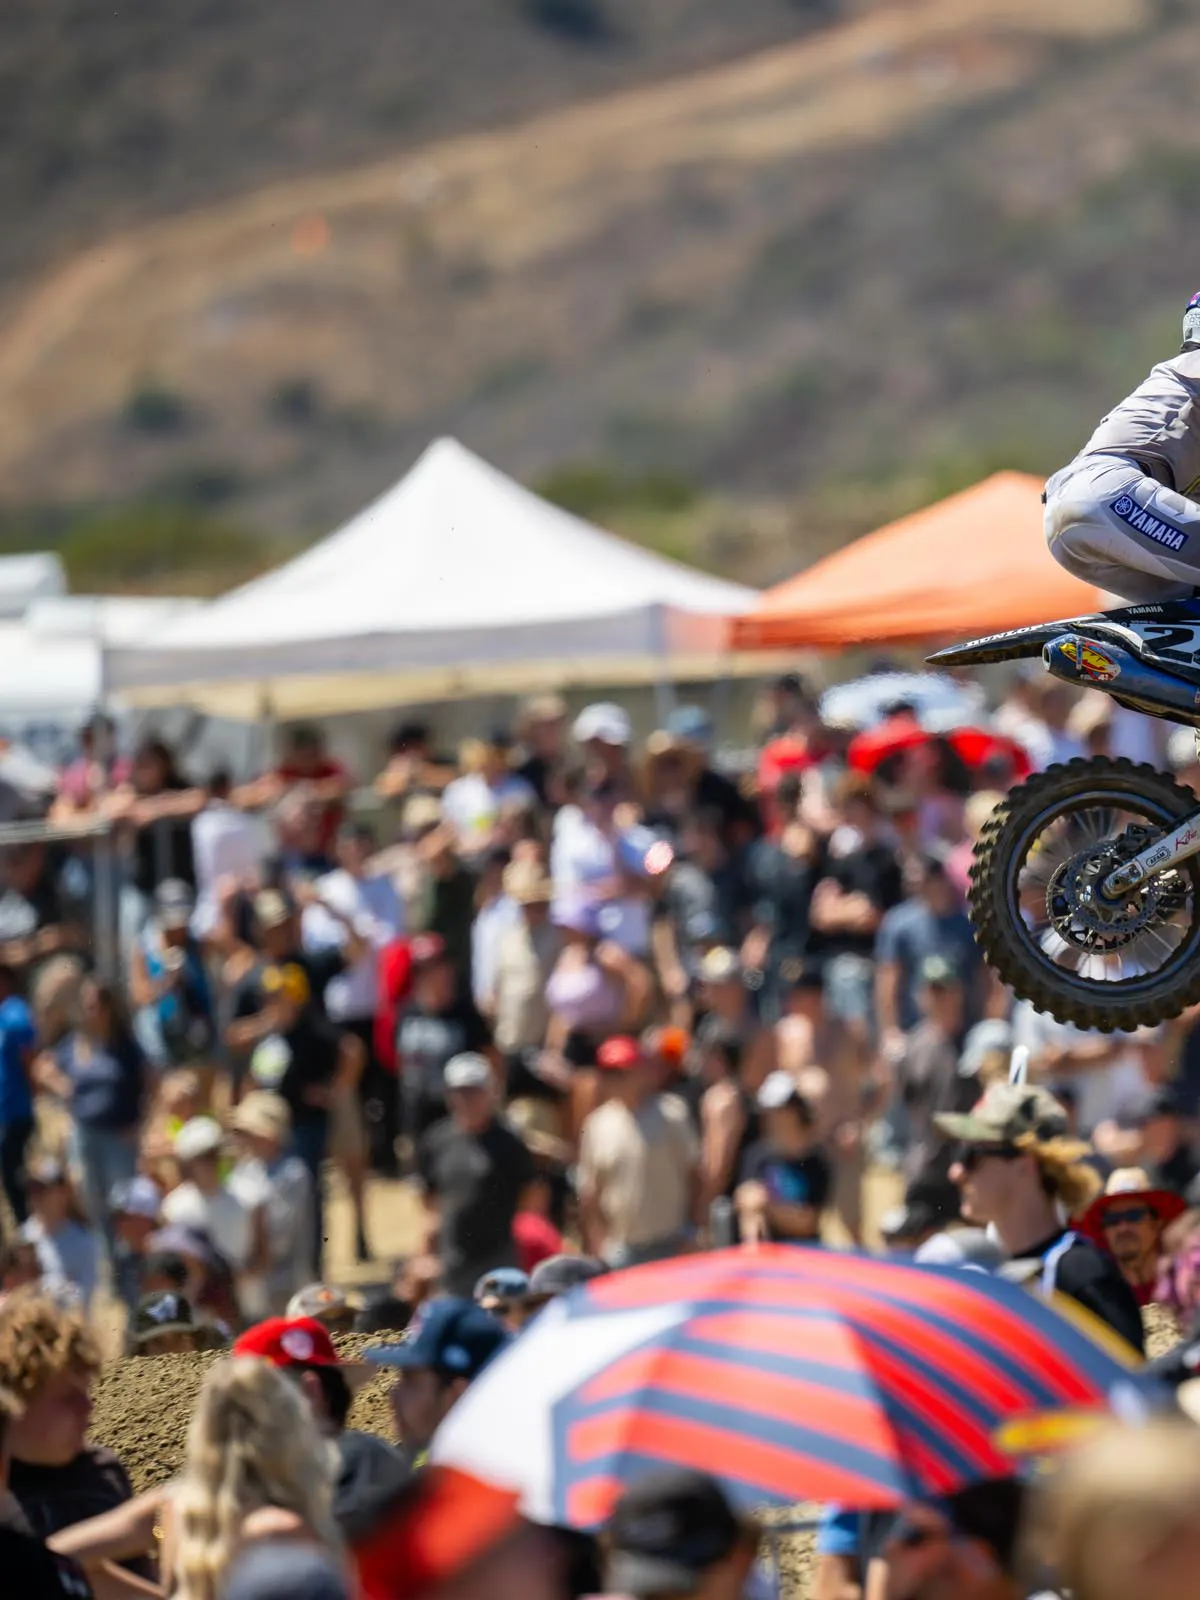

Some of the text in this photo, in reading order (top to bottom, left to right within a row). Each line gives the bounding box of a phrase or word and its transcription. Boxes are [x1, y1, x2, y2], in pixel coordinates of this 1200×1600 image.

[1128, 509, 1184, 551] YAMAHA
[1127, 605, 1164, 615] YAMAHA
[963, 624, 1045, 648] DUNLOP
